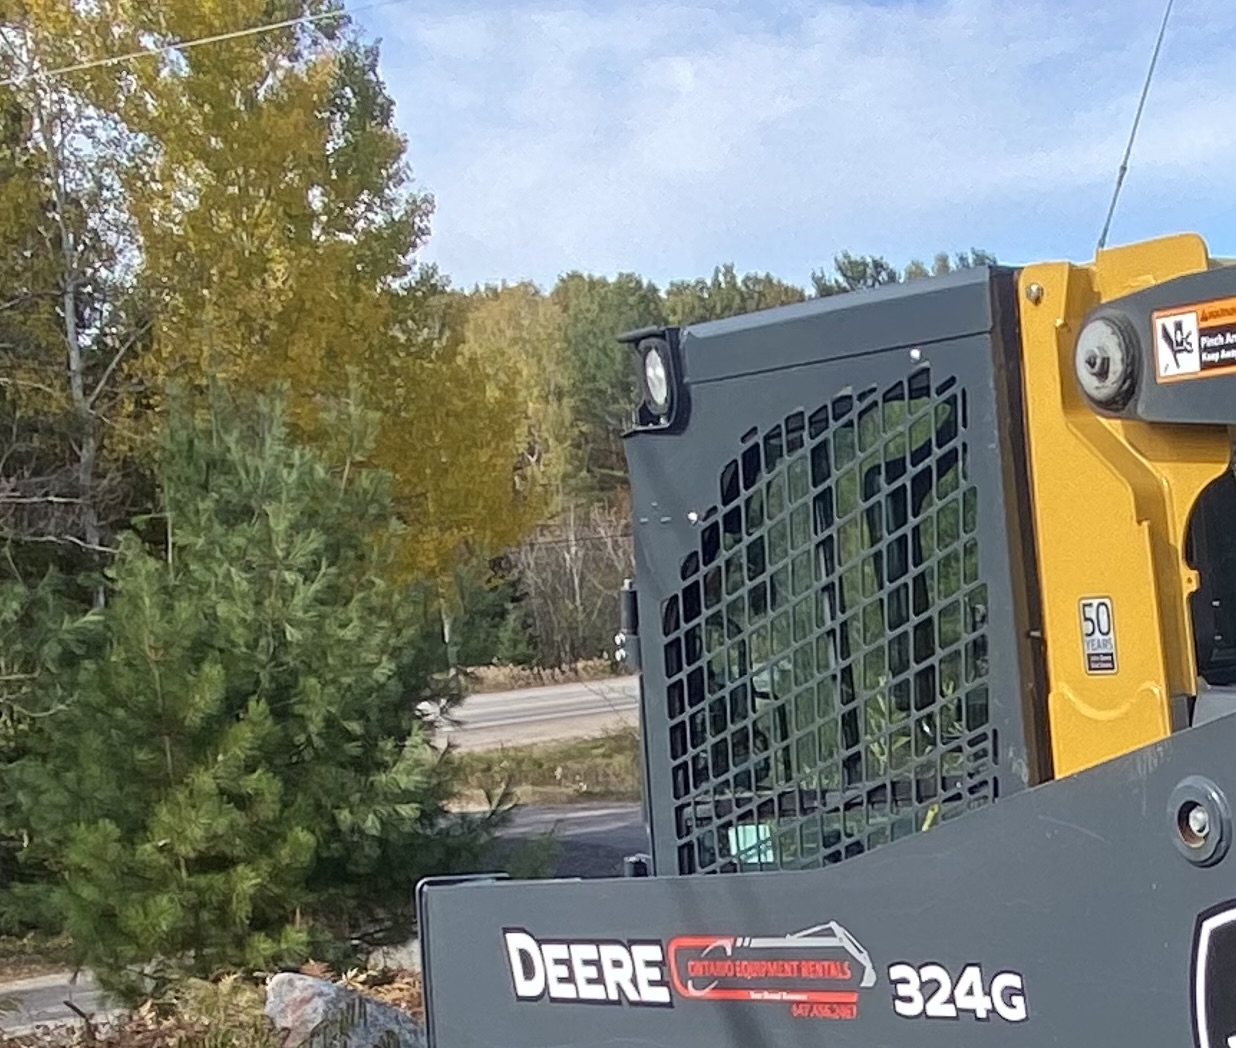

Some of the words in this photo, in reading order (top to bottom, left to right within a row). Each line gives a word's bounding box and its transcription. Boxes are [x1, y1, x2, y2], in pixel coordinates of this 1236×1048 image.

[1200, 333, 1225, 348] Pinch
[1082, 602, 1111, 637] 50
[1085, 637, 1114, 652] YEARS
[503, 929, 673, 1006] DEERE
[687, 960, 735, 977] ONTARIO
[736, 960, 799, 979] EQUIPMENT
[799, 960, 852, 980] RENTALS
[888, 962, 1028, 1022] 324G
